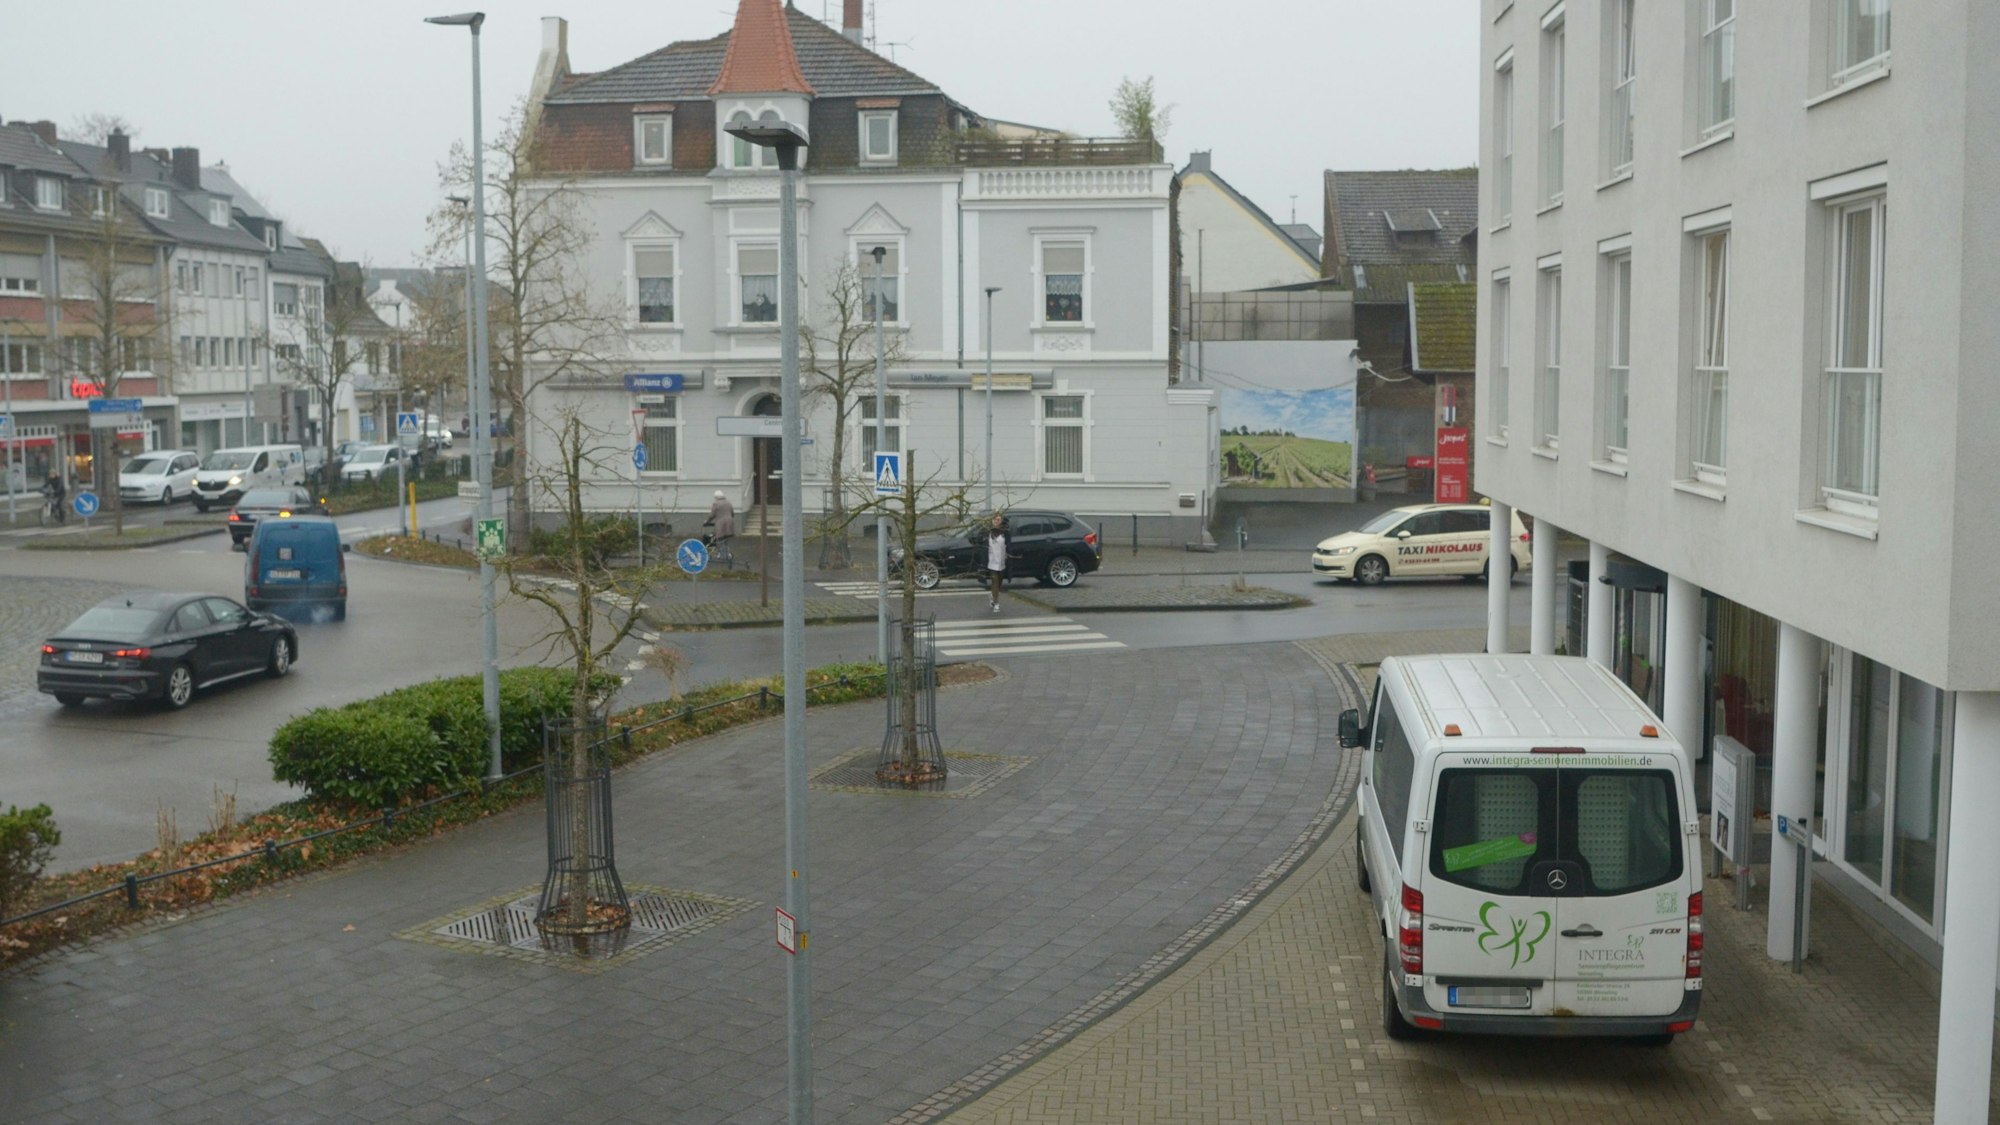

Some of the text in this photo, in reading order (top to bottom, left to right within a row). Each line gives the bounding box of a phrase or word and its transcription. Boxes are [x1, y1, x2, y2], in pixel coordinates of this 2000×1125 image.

[70, 376, 107, 400] tipic
[634, 378, 661, 387] Allianz
[1398, 543, 1483, 556] TAXI NIKOLAUS
[1463, 755, 1653, 767] www.integra-seniorenimmobilien.de
[1579, 949, 1644, 961] INTEGRA
